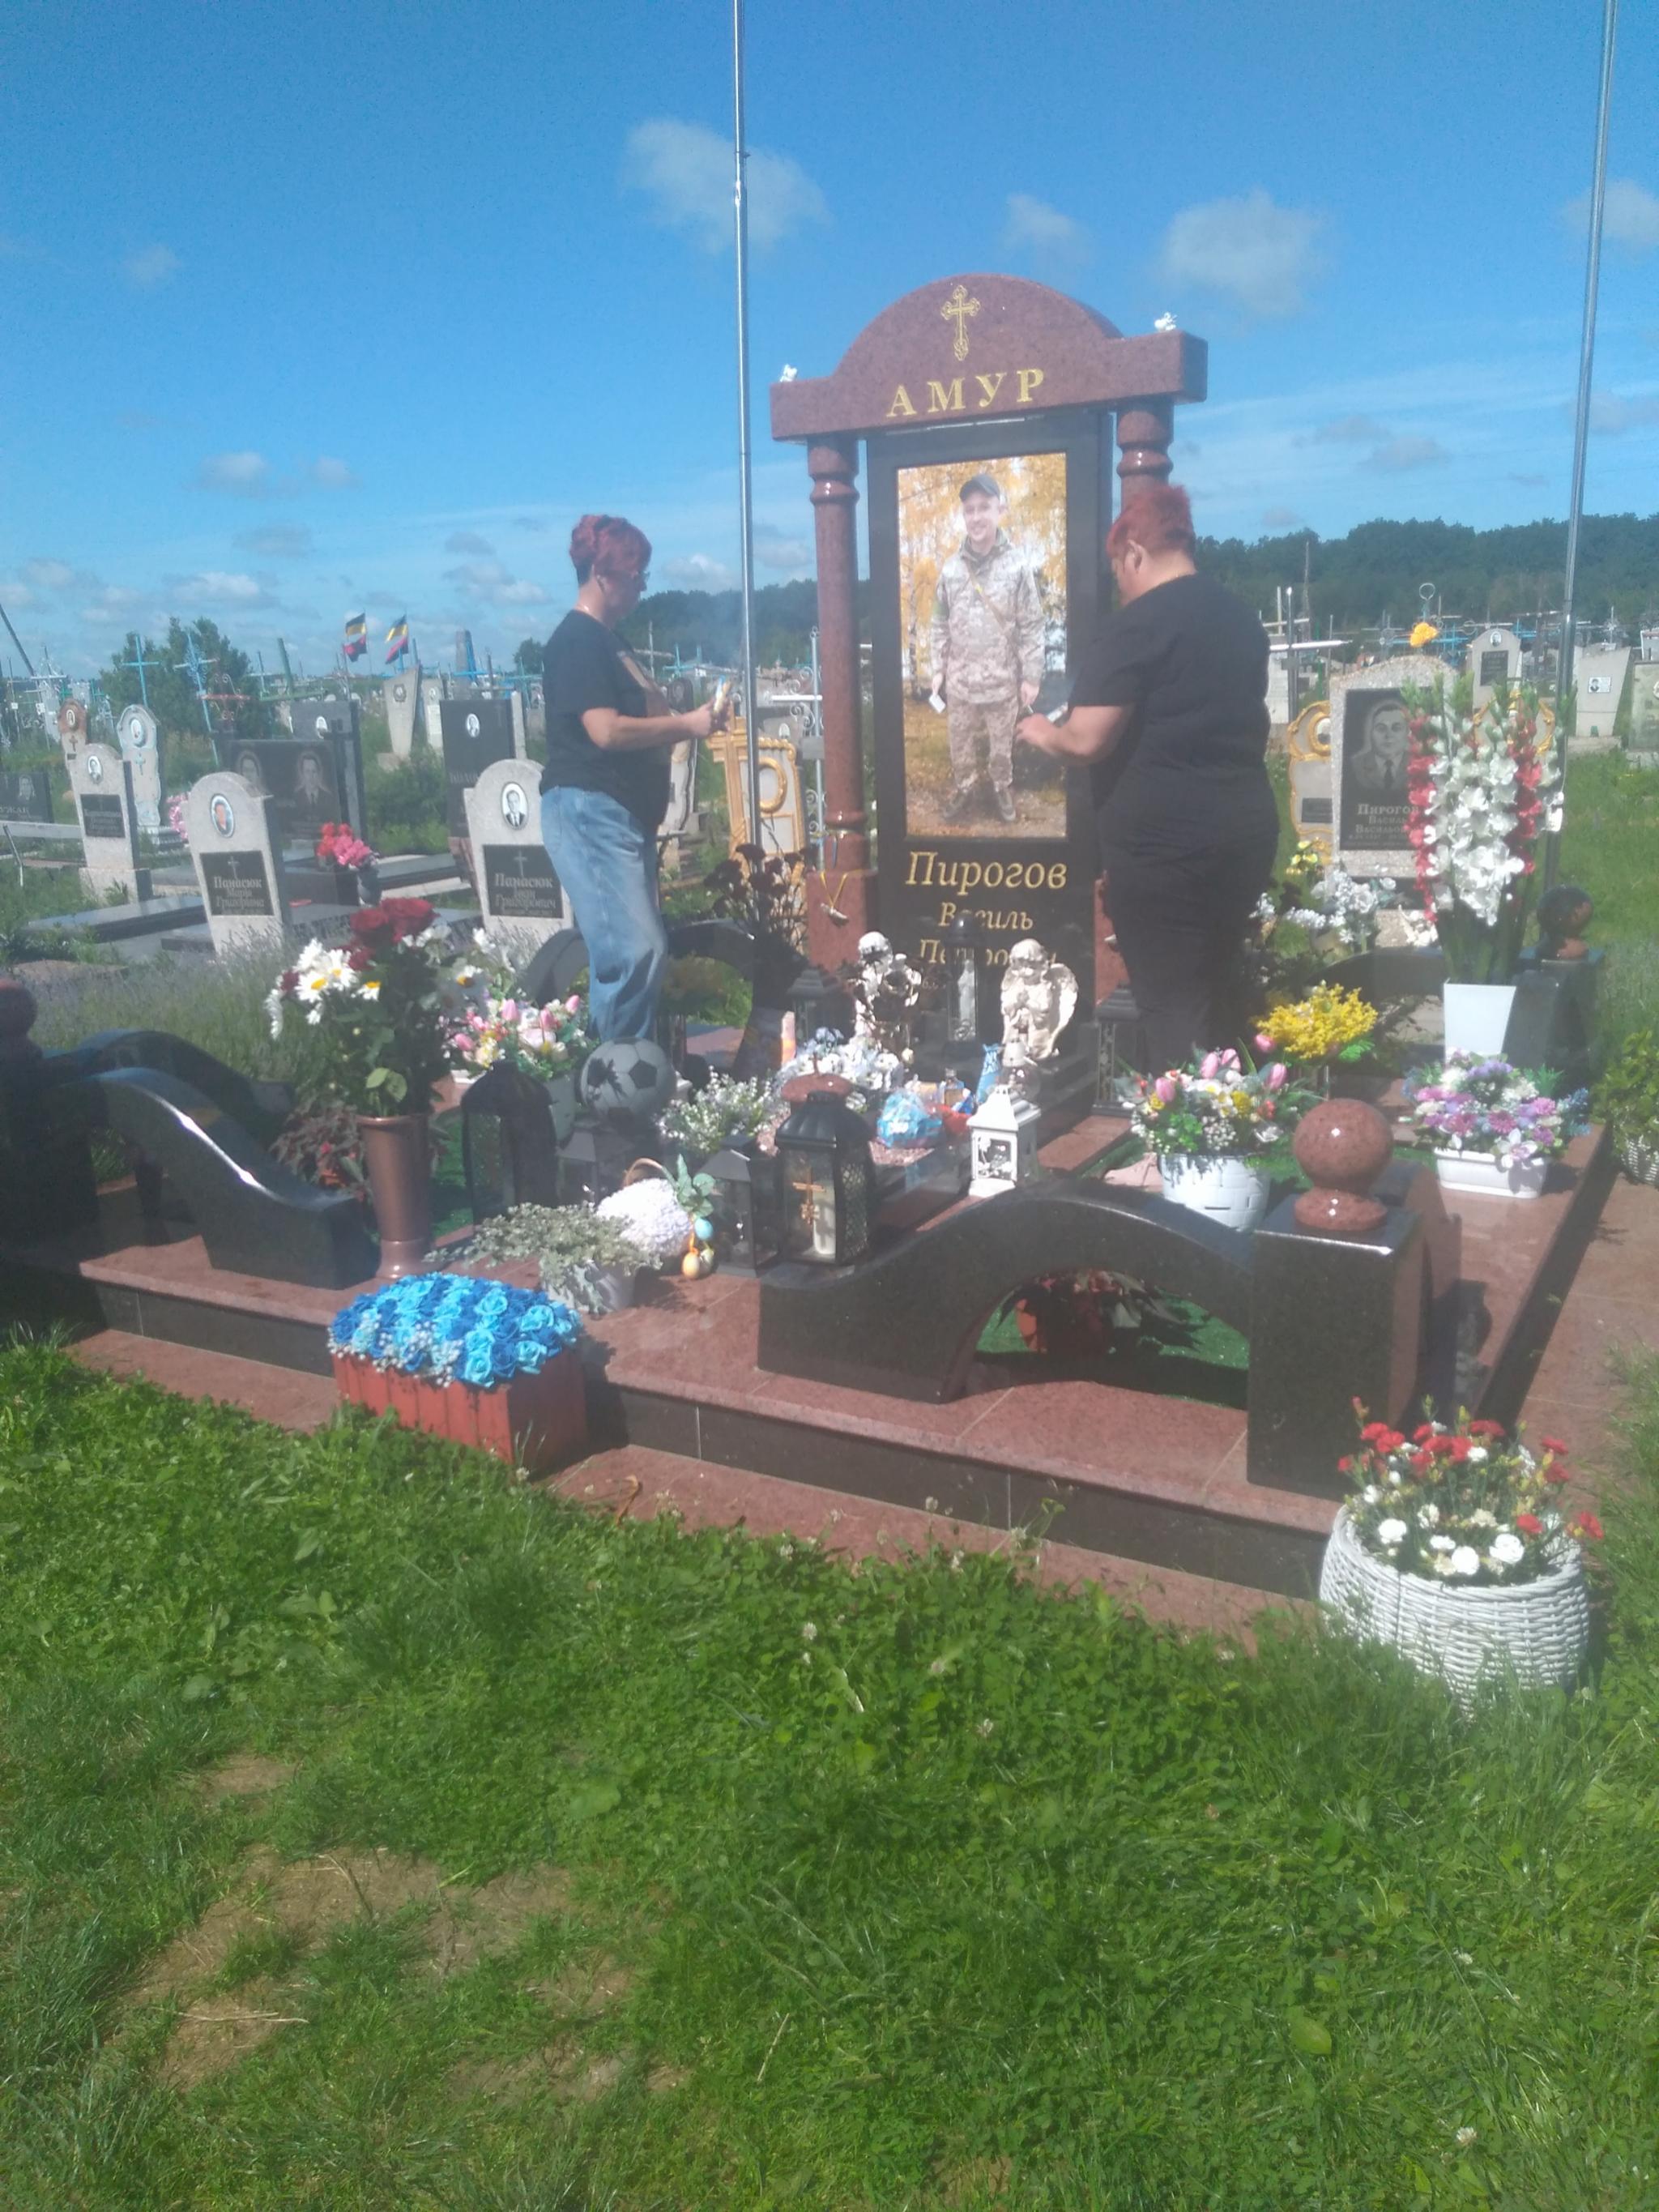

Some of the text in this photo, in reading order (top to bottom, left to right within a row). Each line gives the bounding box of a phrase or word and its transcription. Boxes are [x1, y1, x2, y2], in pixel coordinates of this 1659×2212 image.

[886, 369, 1044, 417] АМУР
[906, 852, 1067, 895] Пирогов
[938, 902, 1034, 930] Всиль
